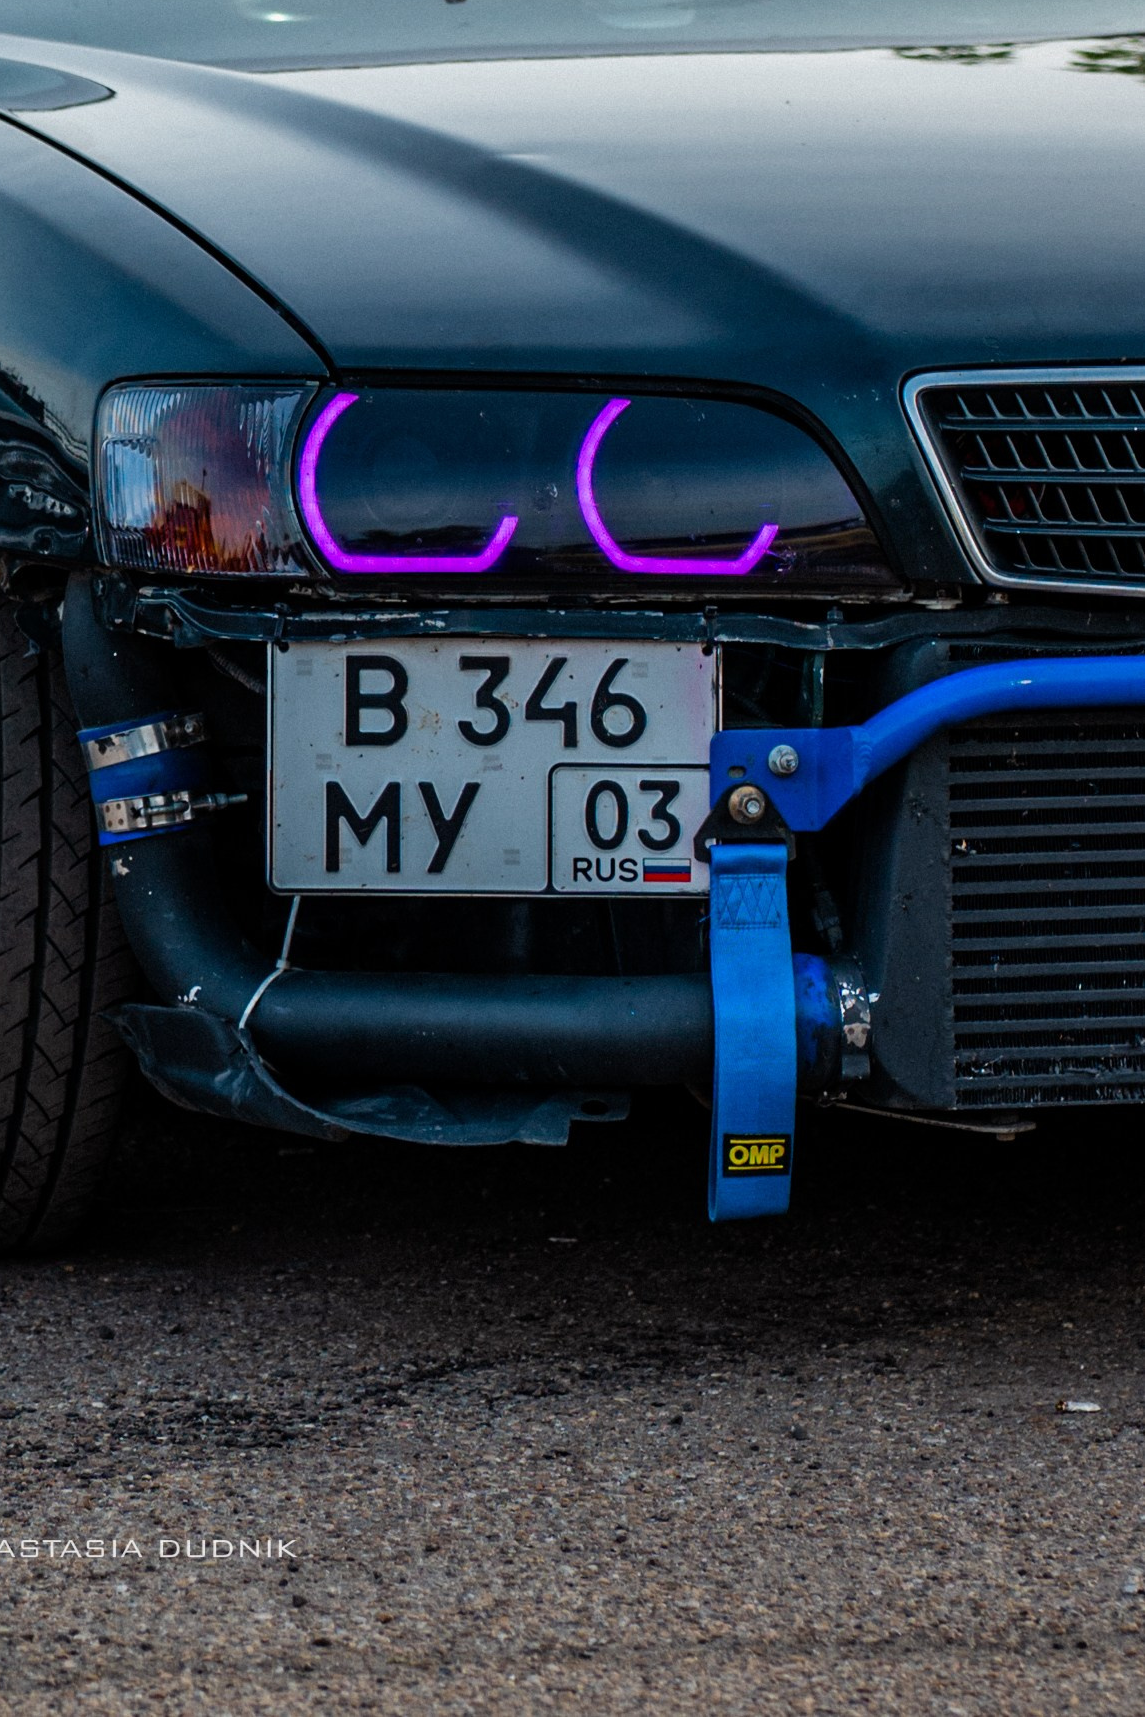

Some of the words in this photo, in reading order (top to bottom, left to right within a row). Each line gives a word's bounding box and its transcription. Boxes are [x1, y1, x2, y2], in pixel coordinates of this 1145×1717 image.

[457, 655, 648, 749] 346
[585, 779, 681, 852] 03
[572, 857, 639, 883] RUS
[728, 1144, 786, 1165] OMP
